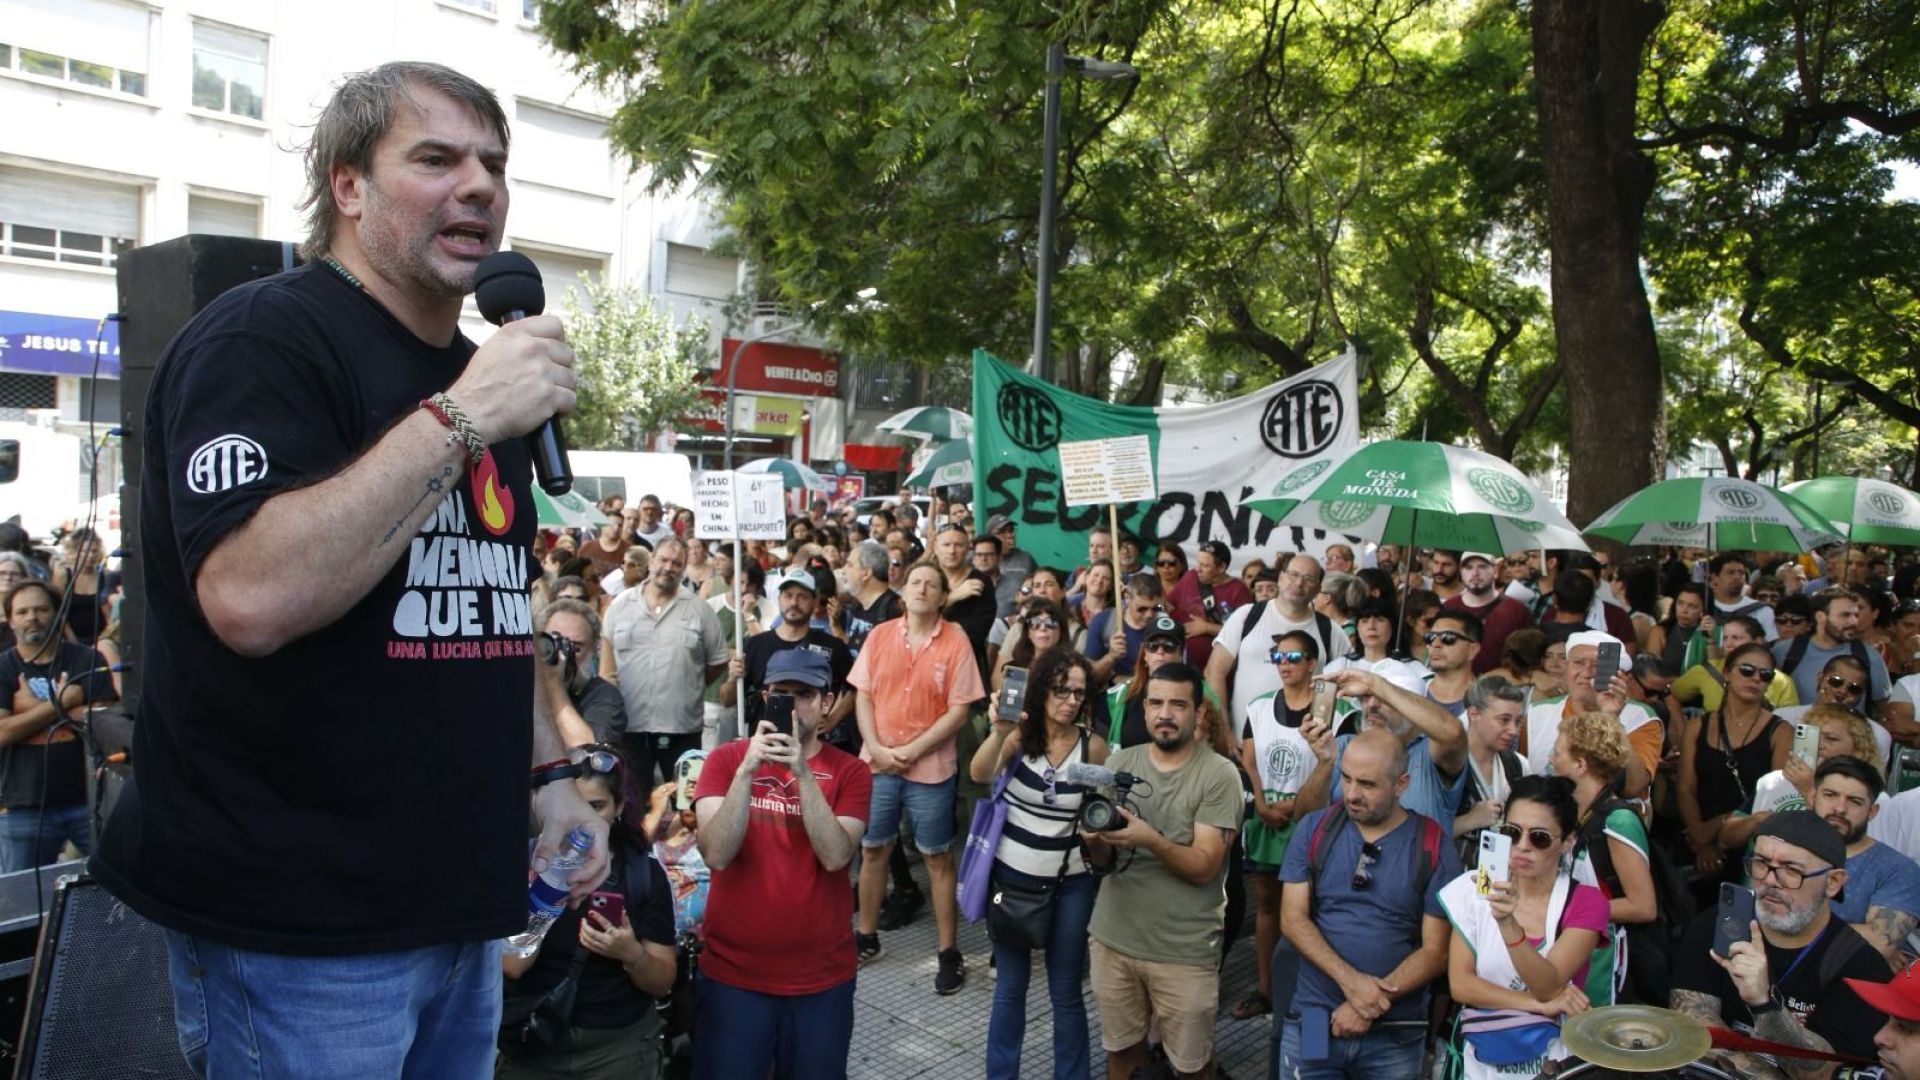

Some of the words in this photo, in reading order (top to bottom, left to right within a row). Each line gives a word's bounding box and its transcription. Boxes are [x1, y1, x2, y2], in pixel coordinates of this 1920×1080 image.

[21, 335, 82, 352] JESUS
[86, 339, 108, 355] TE
[755, 410, 789, 425] arket
[1002, 387, 1056, 445] ATE
[1266, 384, 1333, 452] ATE
[195, 439, 259, 493] ATE
[1365, 468, 1407, 480] CASA
[707, 477, 729, 486] PESO
[1370, 478, 1398, 488] DE
[1342, 485, 1418, 499] MONEDA
[1720, 489, 1755, 506] ATE
[701, 499, 729, 508] HECHO
[752, 500, 766, 514] TU
[711, 513, 722, 521] EN
[406, 536, 528, 589] MEMORIA
[393, 589, 483, 637] QUE
[387, 641, 427, 660] UNA
[432, 641, 481, 660] LUCHA
[484, 640, 502, 660] QUE
[750, 795, 786, 813] OLLISTER
